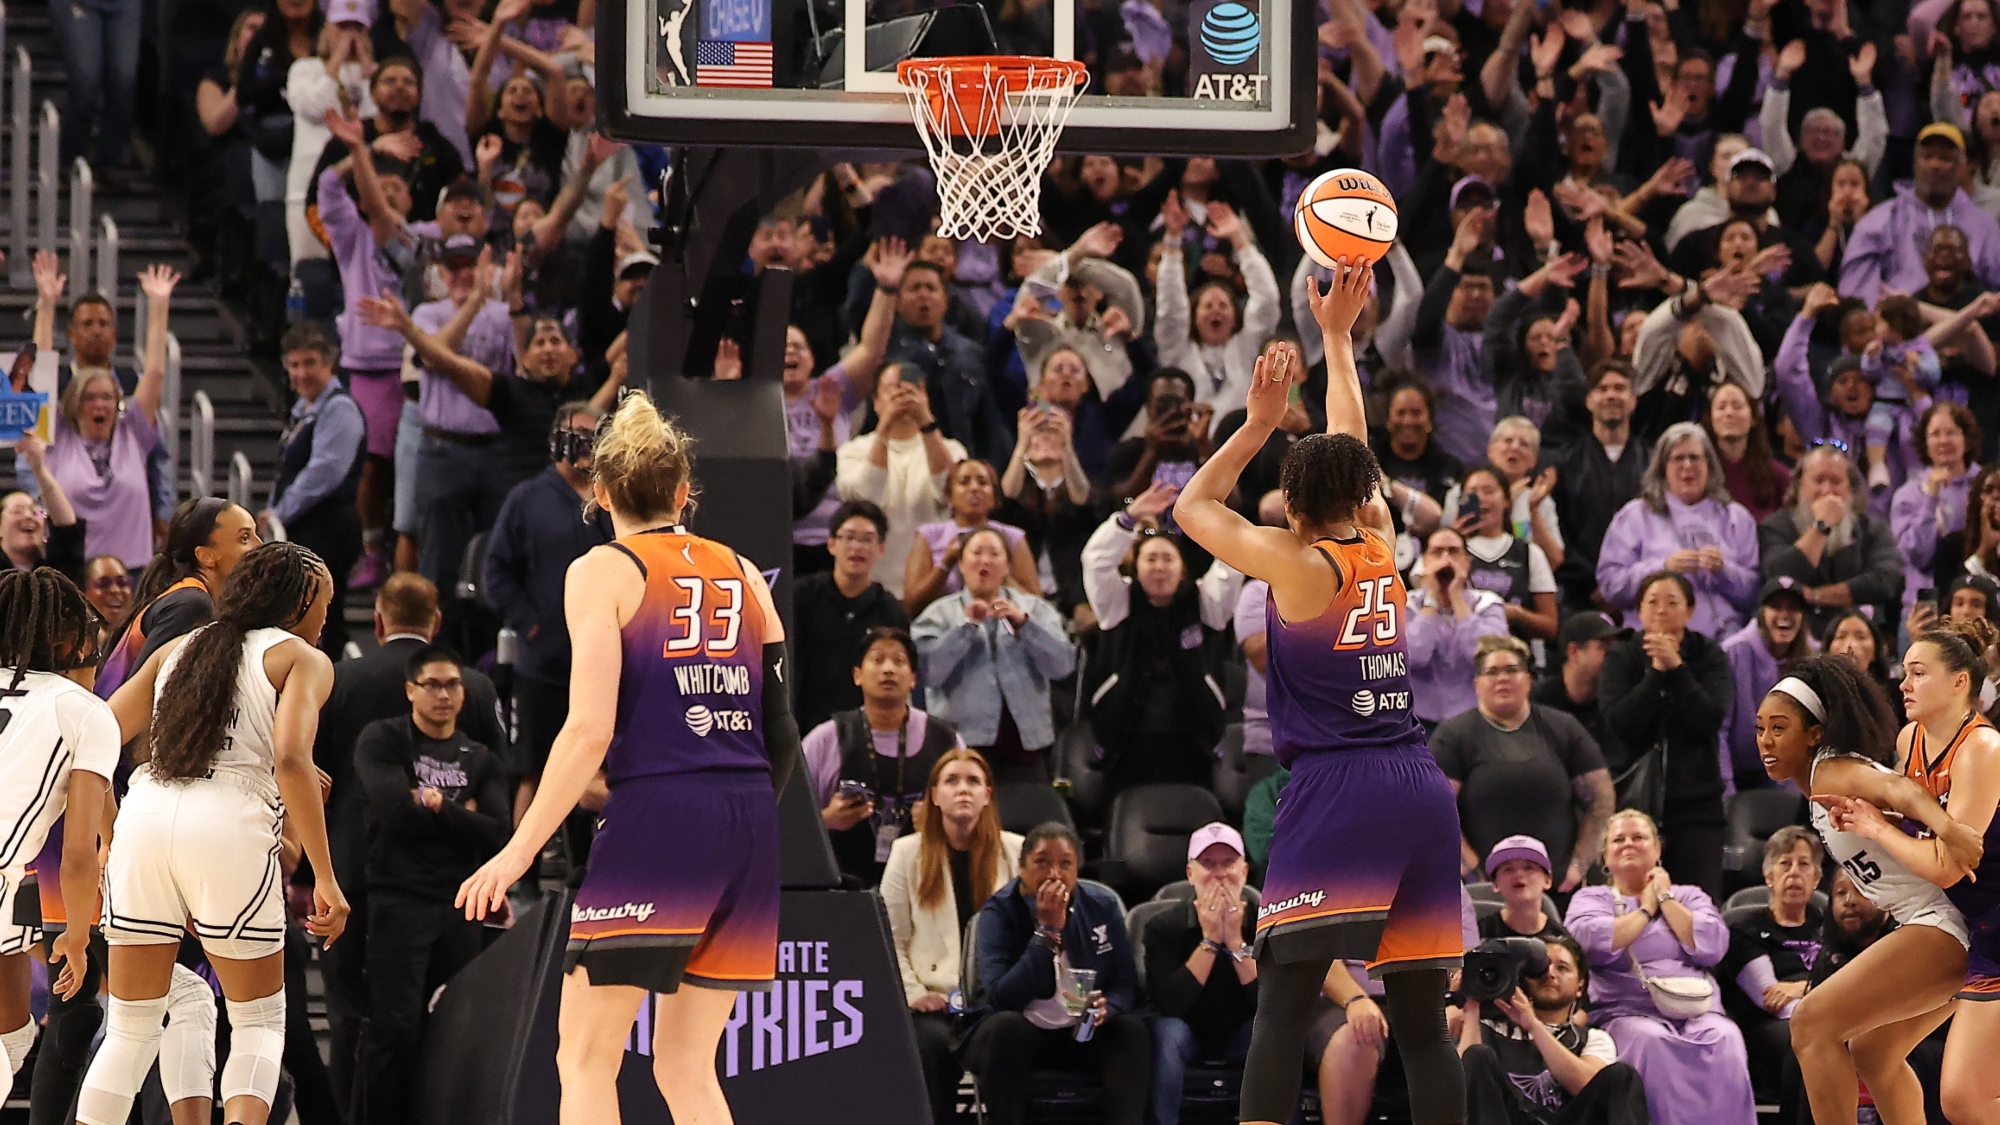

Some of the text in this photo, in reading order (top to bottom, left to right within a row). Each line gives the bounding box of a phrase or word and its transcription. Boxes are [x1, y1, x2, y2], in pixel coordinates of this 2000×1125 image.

[1193, 73, 1269, 101] AT&T
[663, 576, 743, 658] 33
[1333, 575, 1398, 650] 25
[673, 664, 750, 695] WHITCOMB
[1358, 651, 1406, 681] THOMAS
[1378, 691, 1409, 711] AT&T
[778, 941, 829, 973] ATE
